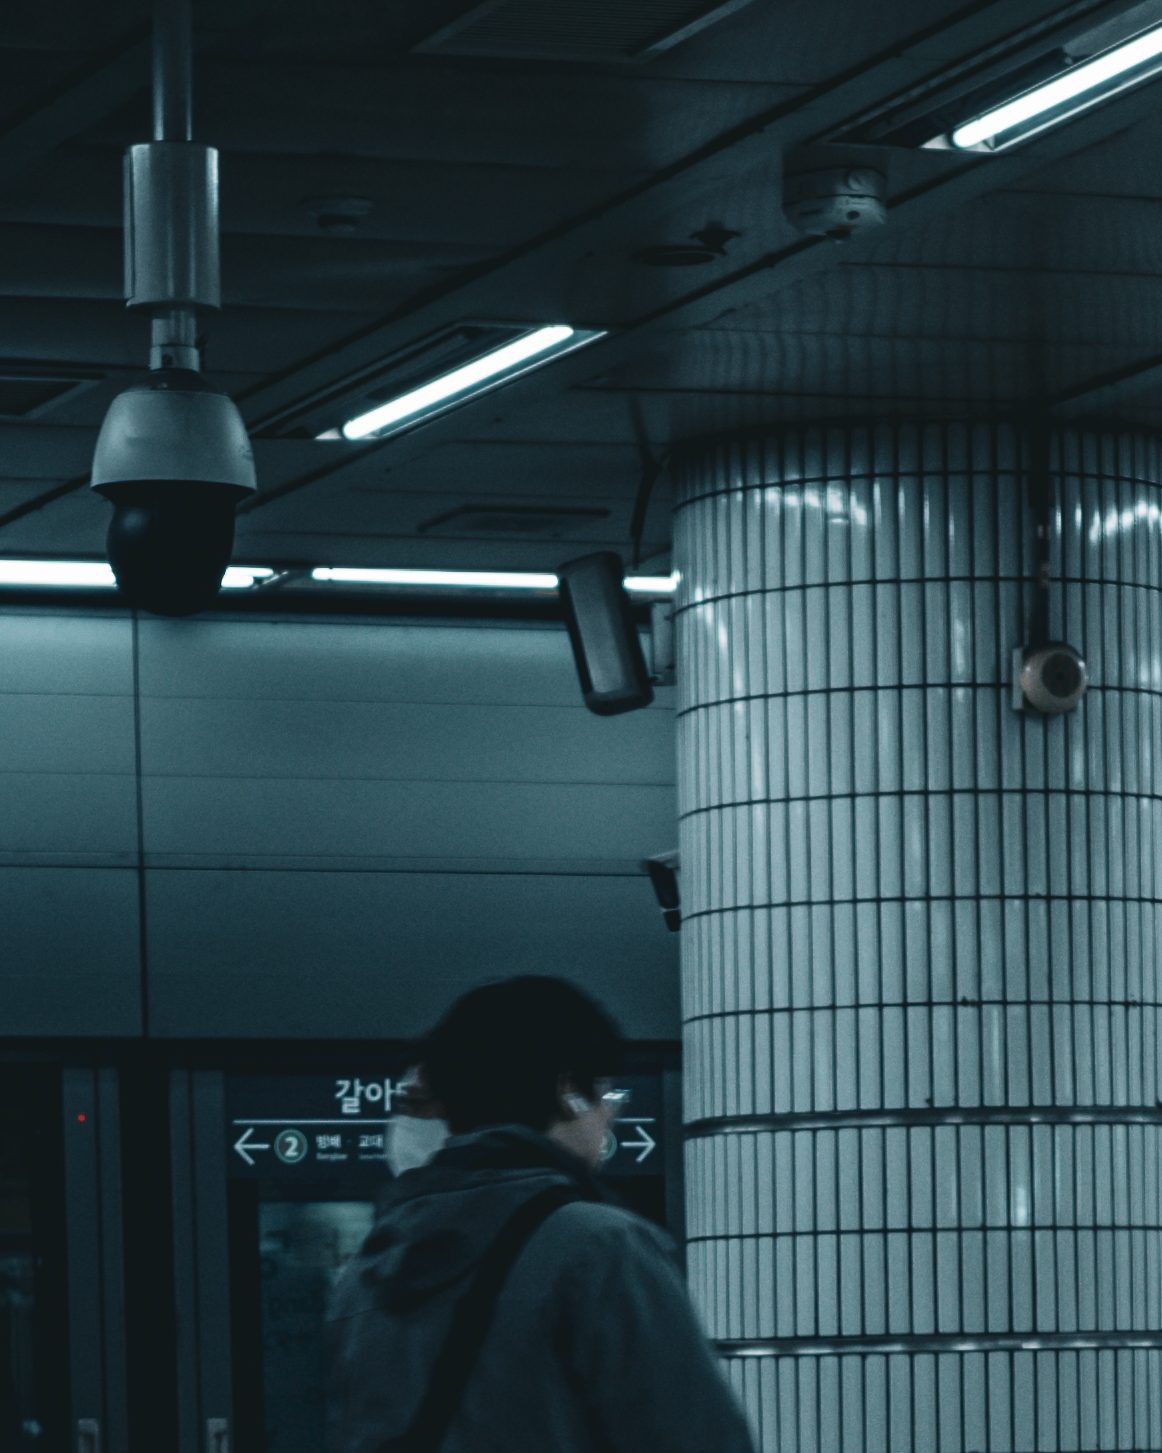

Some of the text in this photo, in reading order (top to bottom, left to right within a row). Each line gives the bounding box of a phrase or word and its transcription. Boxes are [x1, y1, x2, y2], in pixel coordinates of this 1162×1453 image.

[284, 1136, 299, 1157] 2
[315, 1133, 384, 1150] 방배 교대
